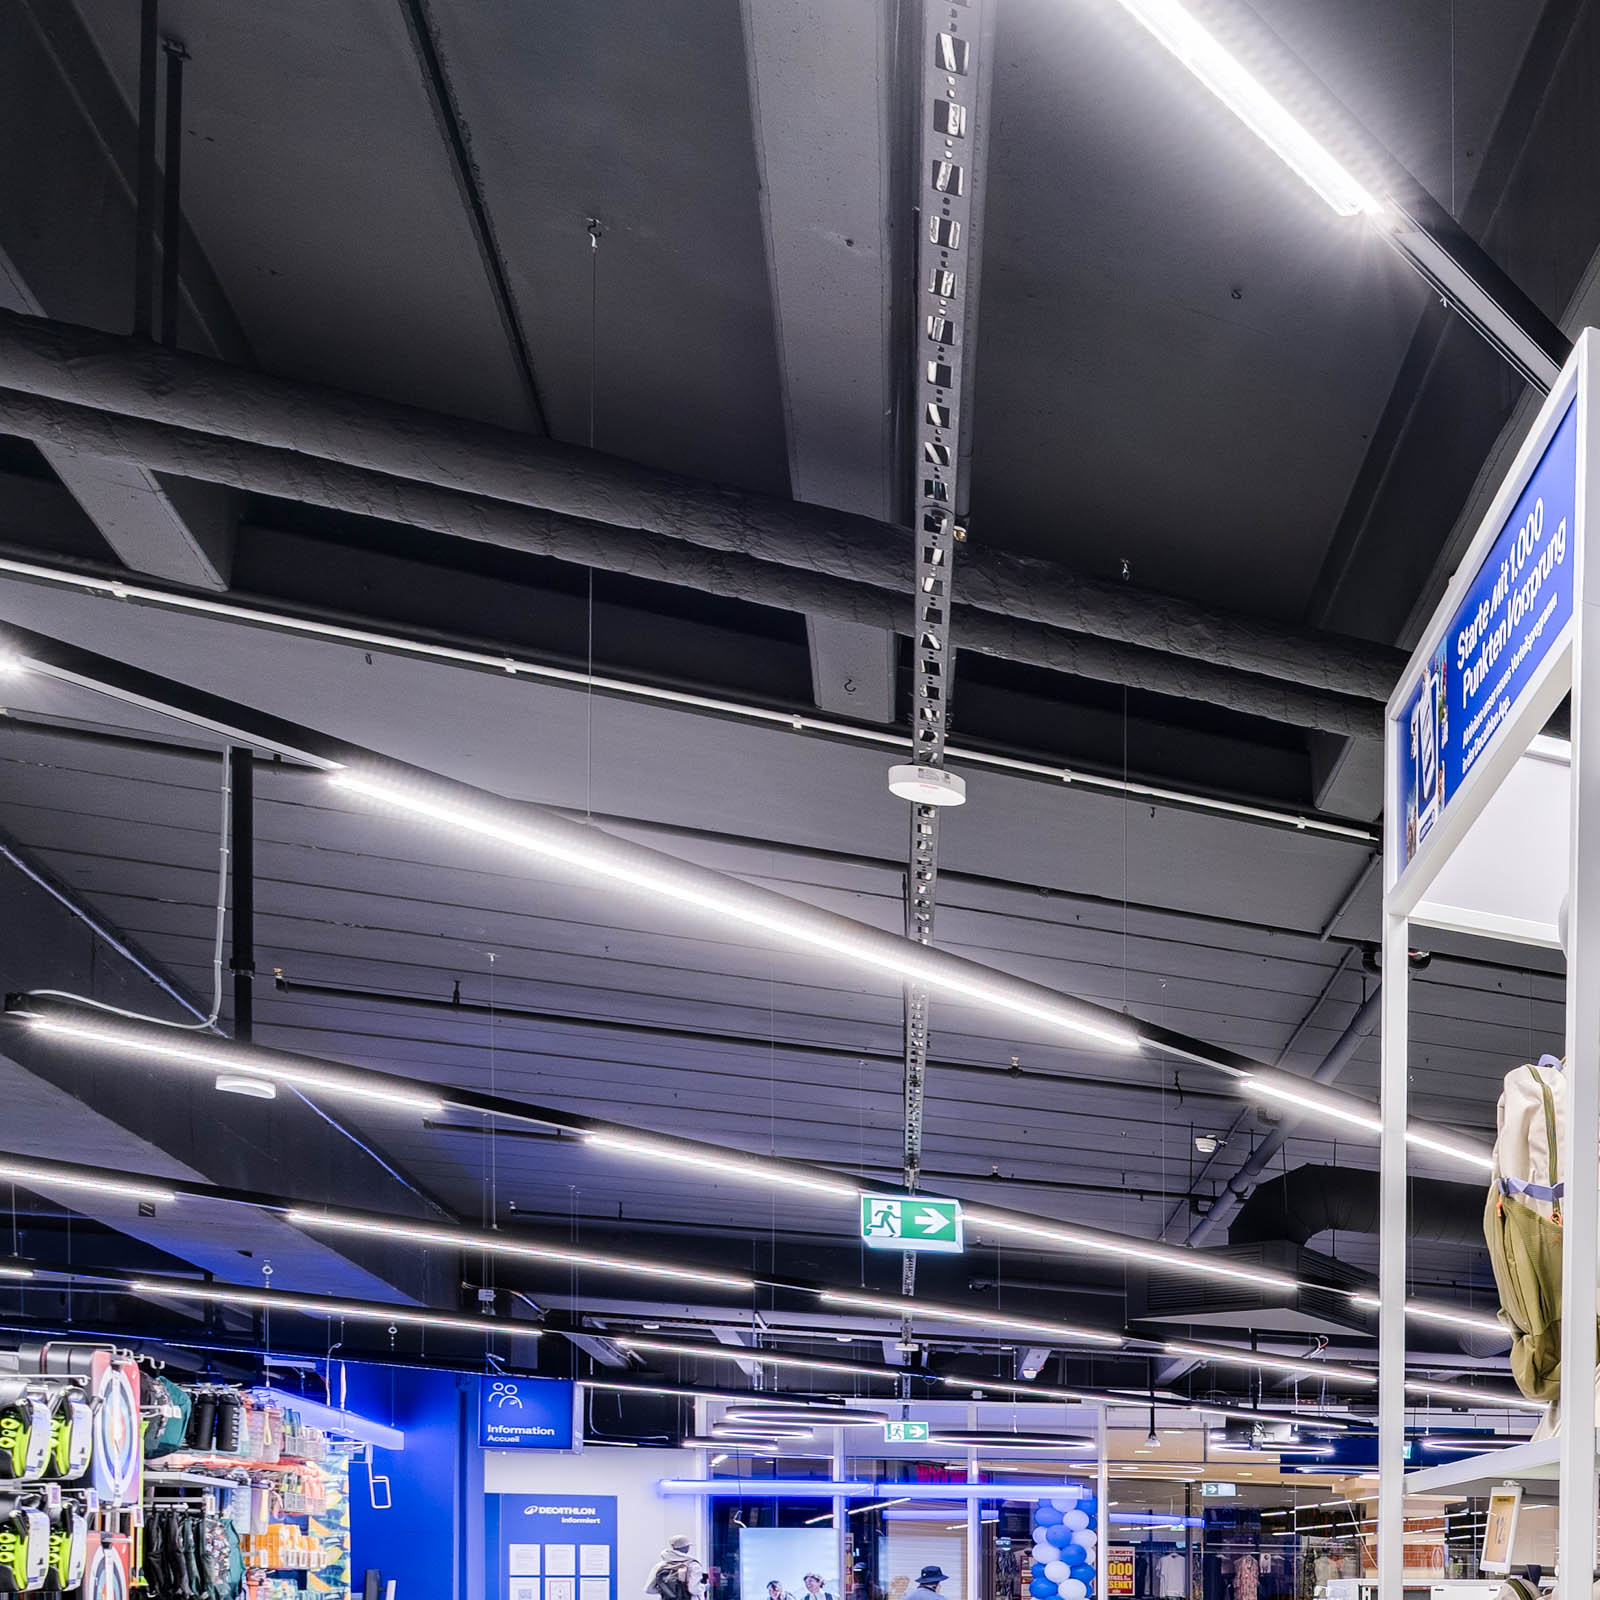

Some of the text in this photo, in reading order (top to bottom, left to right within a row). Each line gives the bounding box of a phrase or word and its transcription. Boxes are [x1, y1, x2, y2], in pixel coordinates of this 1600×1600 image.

[1457, 497, 1544, 670] Starte mit 1.000
[1462, 516, 1567, 710] Punkten Vorsprung
[487, 1424, 555, 1436] Information
[487, 1435, 520, 1443] Accueil
[538, 1507, 596, 1515] DECATHLON
